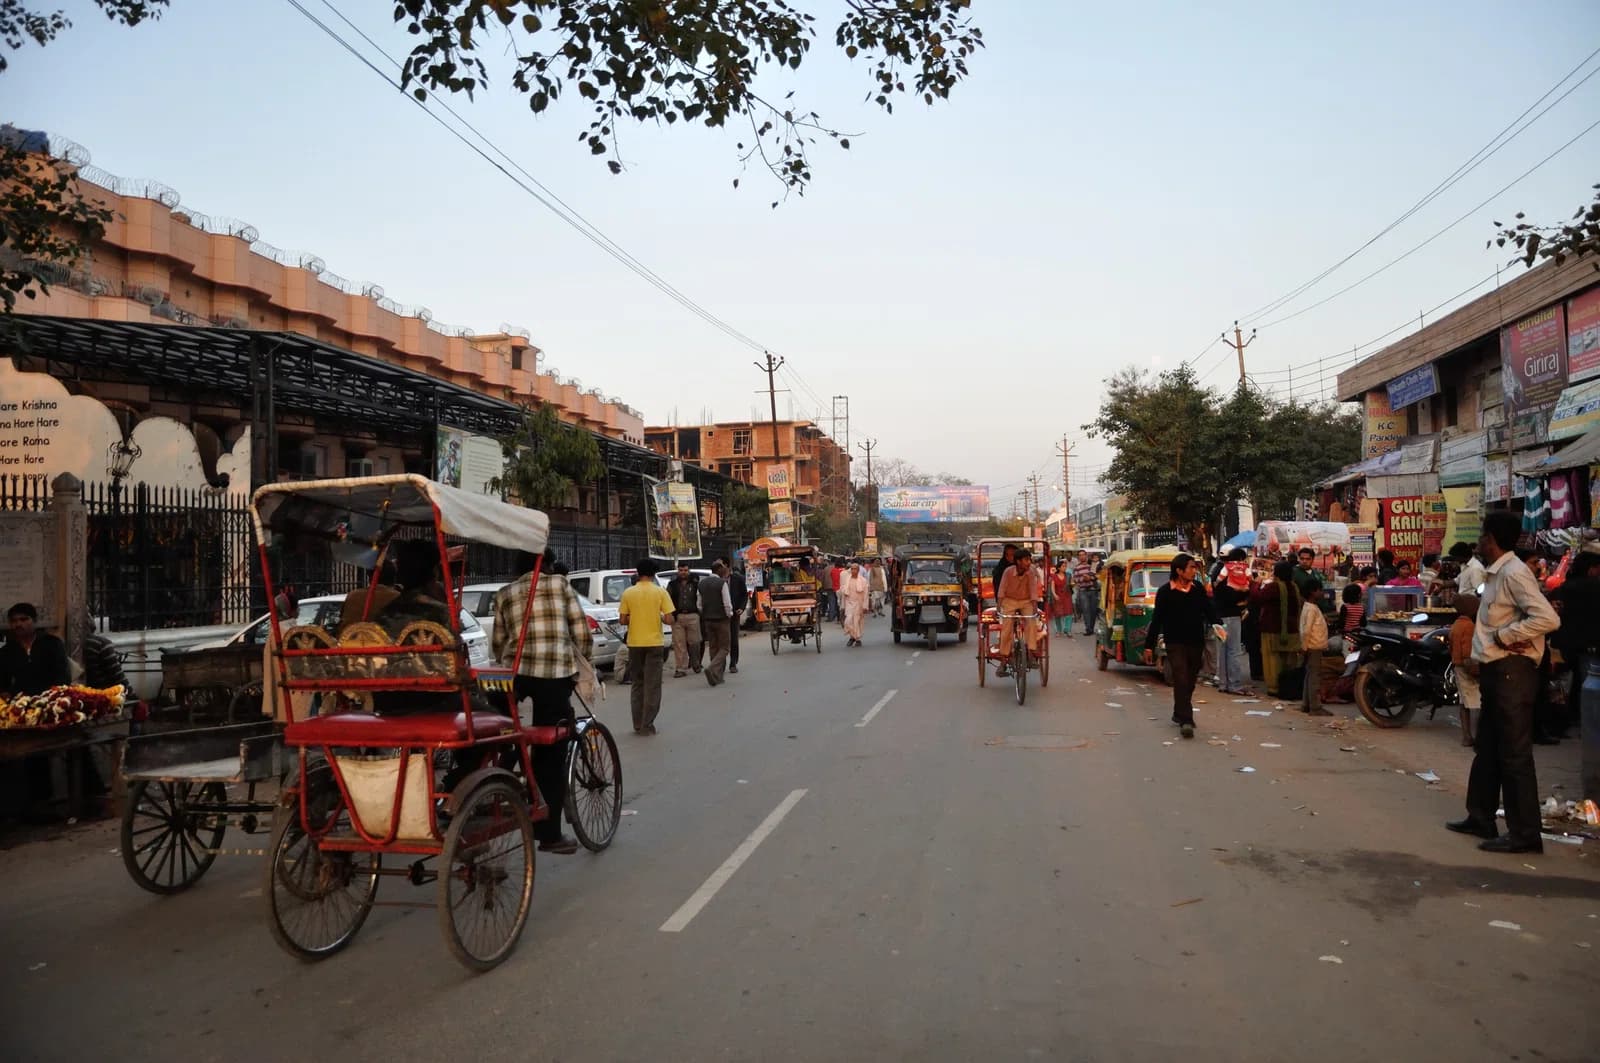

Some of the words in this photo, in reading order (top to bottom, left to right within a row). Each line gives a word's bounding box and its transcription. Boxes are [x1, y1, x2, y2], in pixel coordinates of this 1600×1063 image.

[1524, 347, 1560, 378] Giriraj
[0, 401, 18, 411] are
[22, 400, 58, 410] Krishna
[14, 419, 35, 428] Hare
[37, 417, 59, 427] Hare
[23, 436, 50, 447] Rama
[24, 454, 45, 464] Hare
[883, 497, 919, 509] Sanskar
